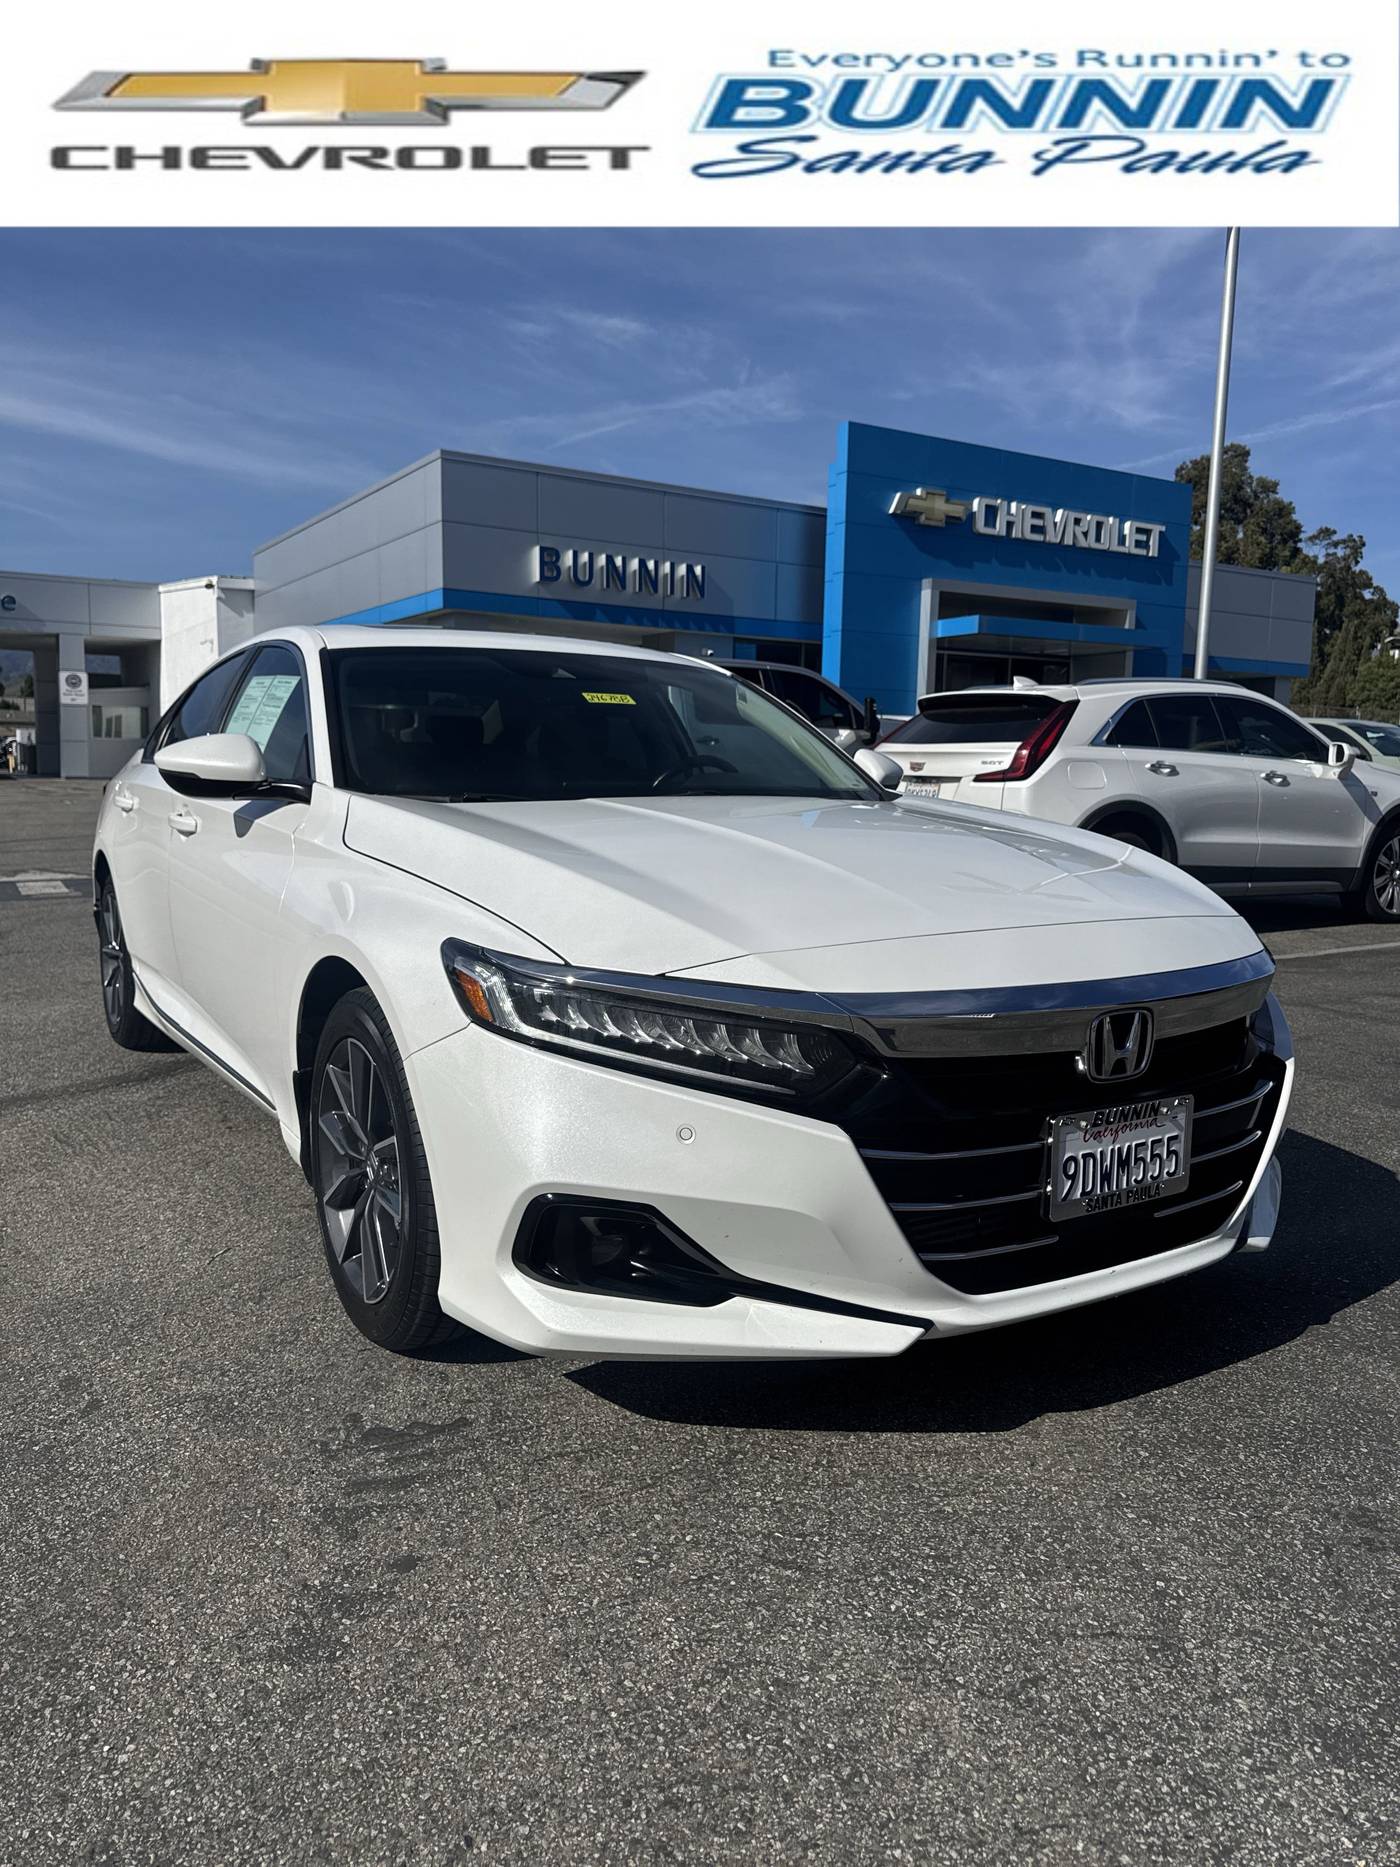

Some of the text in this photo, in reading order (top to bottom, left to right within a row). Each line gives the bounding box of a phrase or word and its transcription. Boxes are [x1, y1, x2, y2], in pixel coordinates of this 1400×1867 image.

[973, 497, 1166, 557] CHEVROLET
[533, 545, 707, 600] BUNNIN
[1092, 1101, 1160, 1128] BUNNIN
[1060, 1134, 1179, 1202] 9DWM555
[1085, 1184, 1161, 1213] SANTA PAULA
